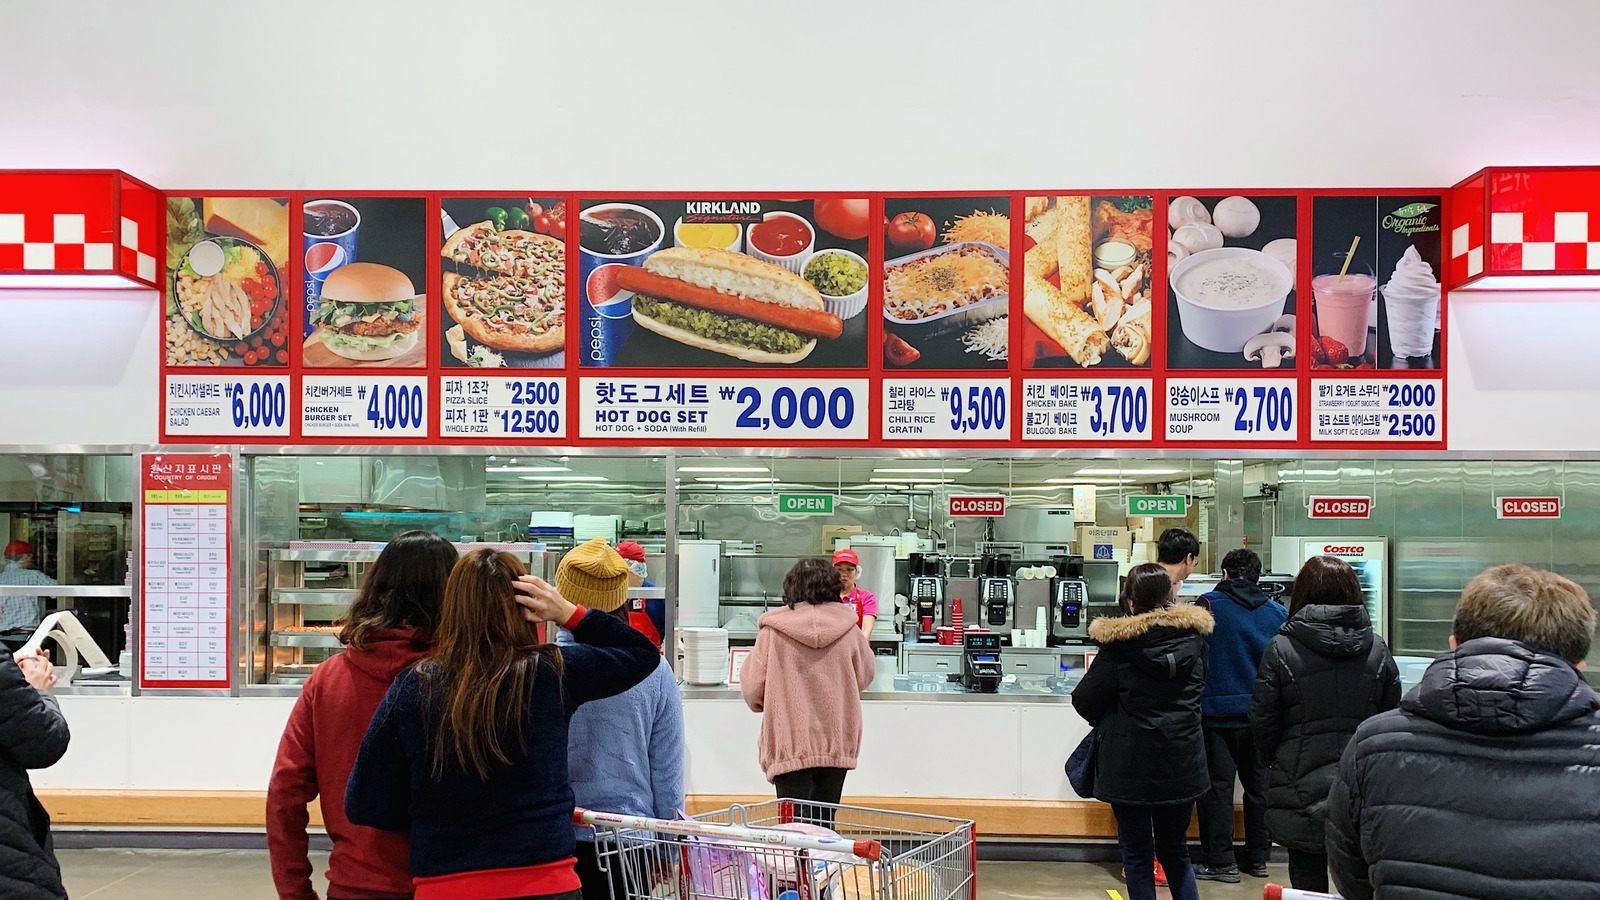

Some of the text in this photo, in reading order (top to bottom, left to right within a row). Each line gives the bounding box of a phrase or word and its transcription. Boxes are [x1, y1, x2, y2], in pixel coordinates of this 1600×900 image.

[686, 201, 761, 214] KIRKLAND
[686, 213, 760, 224] Signature
[1382, 215, 1427, 233] Organic
[1401, 224, 1440, 237] Ingredients
[304, 280, 317, 312] pepsi
[587, 317, 605, 361] pepsi
[169, 383, 220, 398] 치킨시저샐러드
[304, 385, 353, 398] 치킨버거세트
[445, 380, 489, 395] 피자 1조각
[595, 382, 710, 405] 핫도그세트
[888, 386, 936, 398] 칠리 라이스
[1026, 384, 1078, 399] 치킨 베이크
[1318, 384, 1380, 398] 딸기 요거트 스무디
[445, 396, 488, 404] PIZZA SLICE
[1169, 385, 1220, 406] 양송이스프
[888, 399, 916, 411] 그라탕
[1026, 399, 1078, 408] CHICKEN BAKE
[169, 407, 221, 416] CHICKEN CAESAR
[445, 408, 489, 423] 피자 1판
[595, 410, 709, 423] HOT DOG SET
[1169, 412, 1220, 422] MUSHROOM
[169, 418, 190, 427] SALAD
[888, 415, 936, 424] CHILI RICE
[1026, 411, 1078, 427] 불고기 베이크
[1318, 414, 1381, 427] 밀크 소프트 아이스크림
[445, 425, 489, 433] WHOLE PIZZA
[595, 424, 614, 432] HOT
[615, 424, 635, 432] DOG
[643, 424, 669, 433] SODA
[669, 425, 687, 433] (With
[688, 424, 707, 433] Refill)
[888, 425, 923, 434] GRATIN
[1026, 427, 1078, 435] BULGOGI BAKE
[1169, 424, 1194, 434] SOUP
[1318, 428, 1381, 436] MILK SOFT ICE CREAM
[787, 497, 825, 509] OPEN
[951, 500, 1003, 512] CLOSED
[1136, 499, 1177, 511] OPEN
[1314, 501, 1367, 514] CLOSED
[1503, 501, 1557, 514] CLOSED
